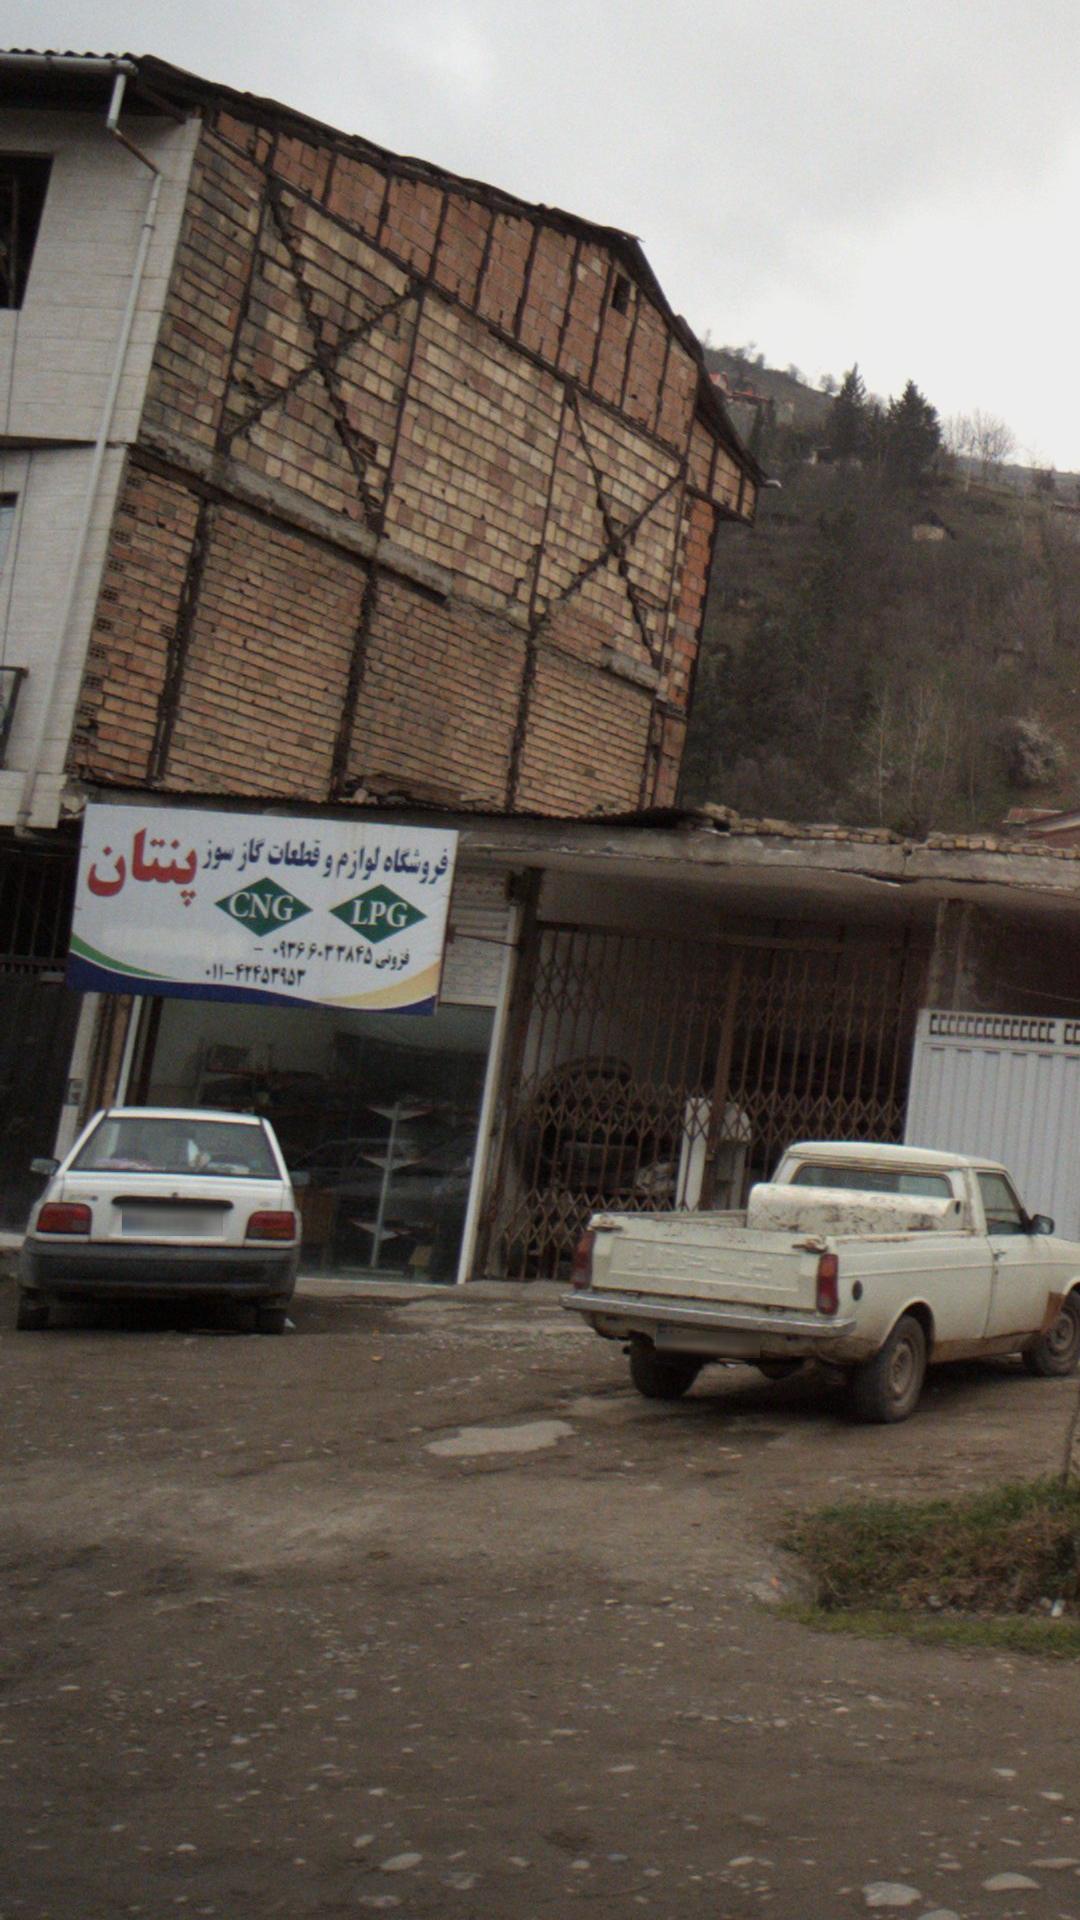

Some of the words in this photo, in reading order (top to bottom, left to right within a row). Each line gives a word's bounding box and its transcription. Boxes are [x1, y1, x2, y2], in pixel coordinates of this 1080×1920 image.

[87, 827, 198, 908] پنتان
[267, 838, 321, 868] قطعات
[322, 852, 334, 878] و
[336, 844, 381, 880] لوازم
[383, 846, 449, 885] فروشگاه
[228, 891, 295, 922] CNG
[350, 899, 410, 929] LPG
